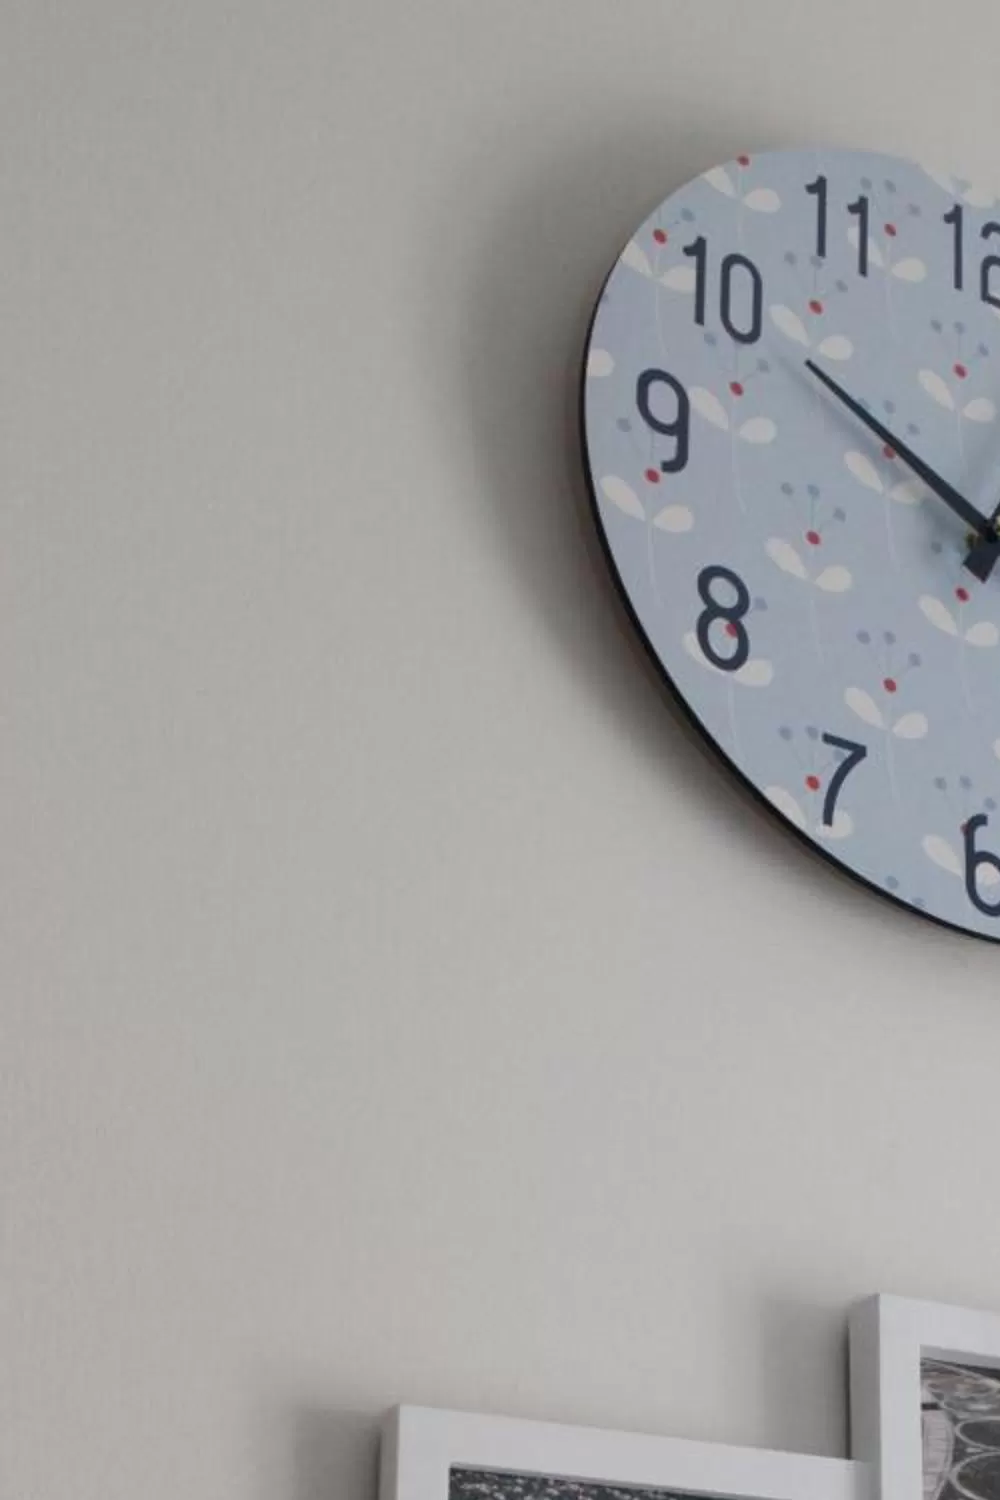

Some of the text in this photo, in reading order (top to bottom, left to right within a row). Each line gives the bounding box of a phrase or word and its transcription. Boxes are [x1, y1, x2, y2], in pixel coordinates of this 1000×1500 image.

[805, 175, 869, 278] 11
[682, 235, 763, 345] 10
[635, 368, 690, 474] 9
[696, 565, 751, 672] 8
[821, 732, 867, 827] 7
